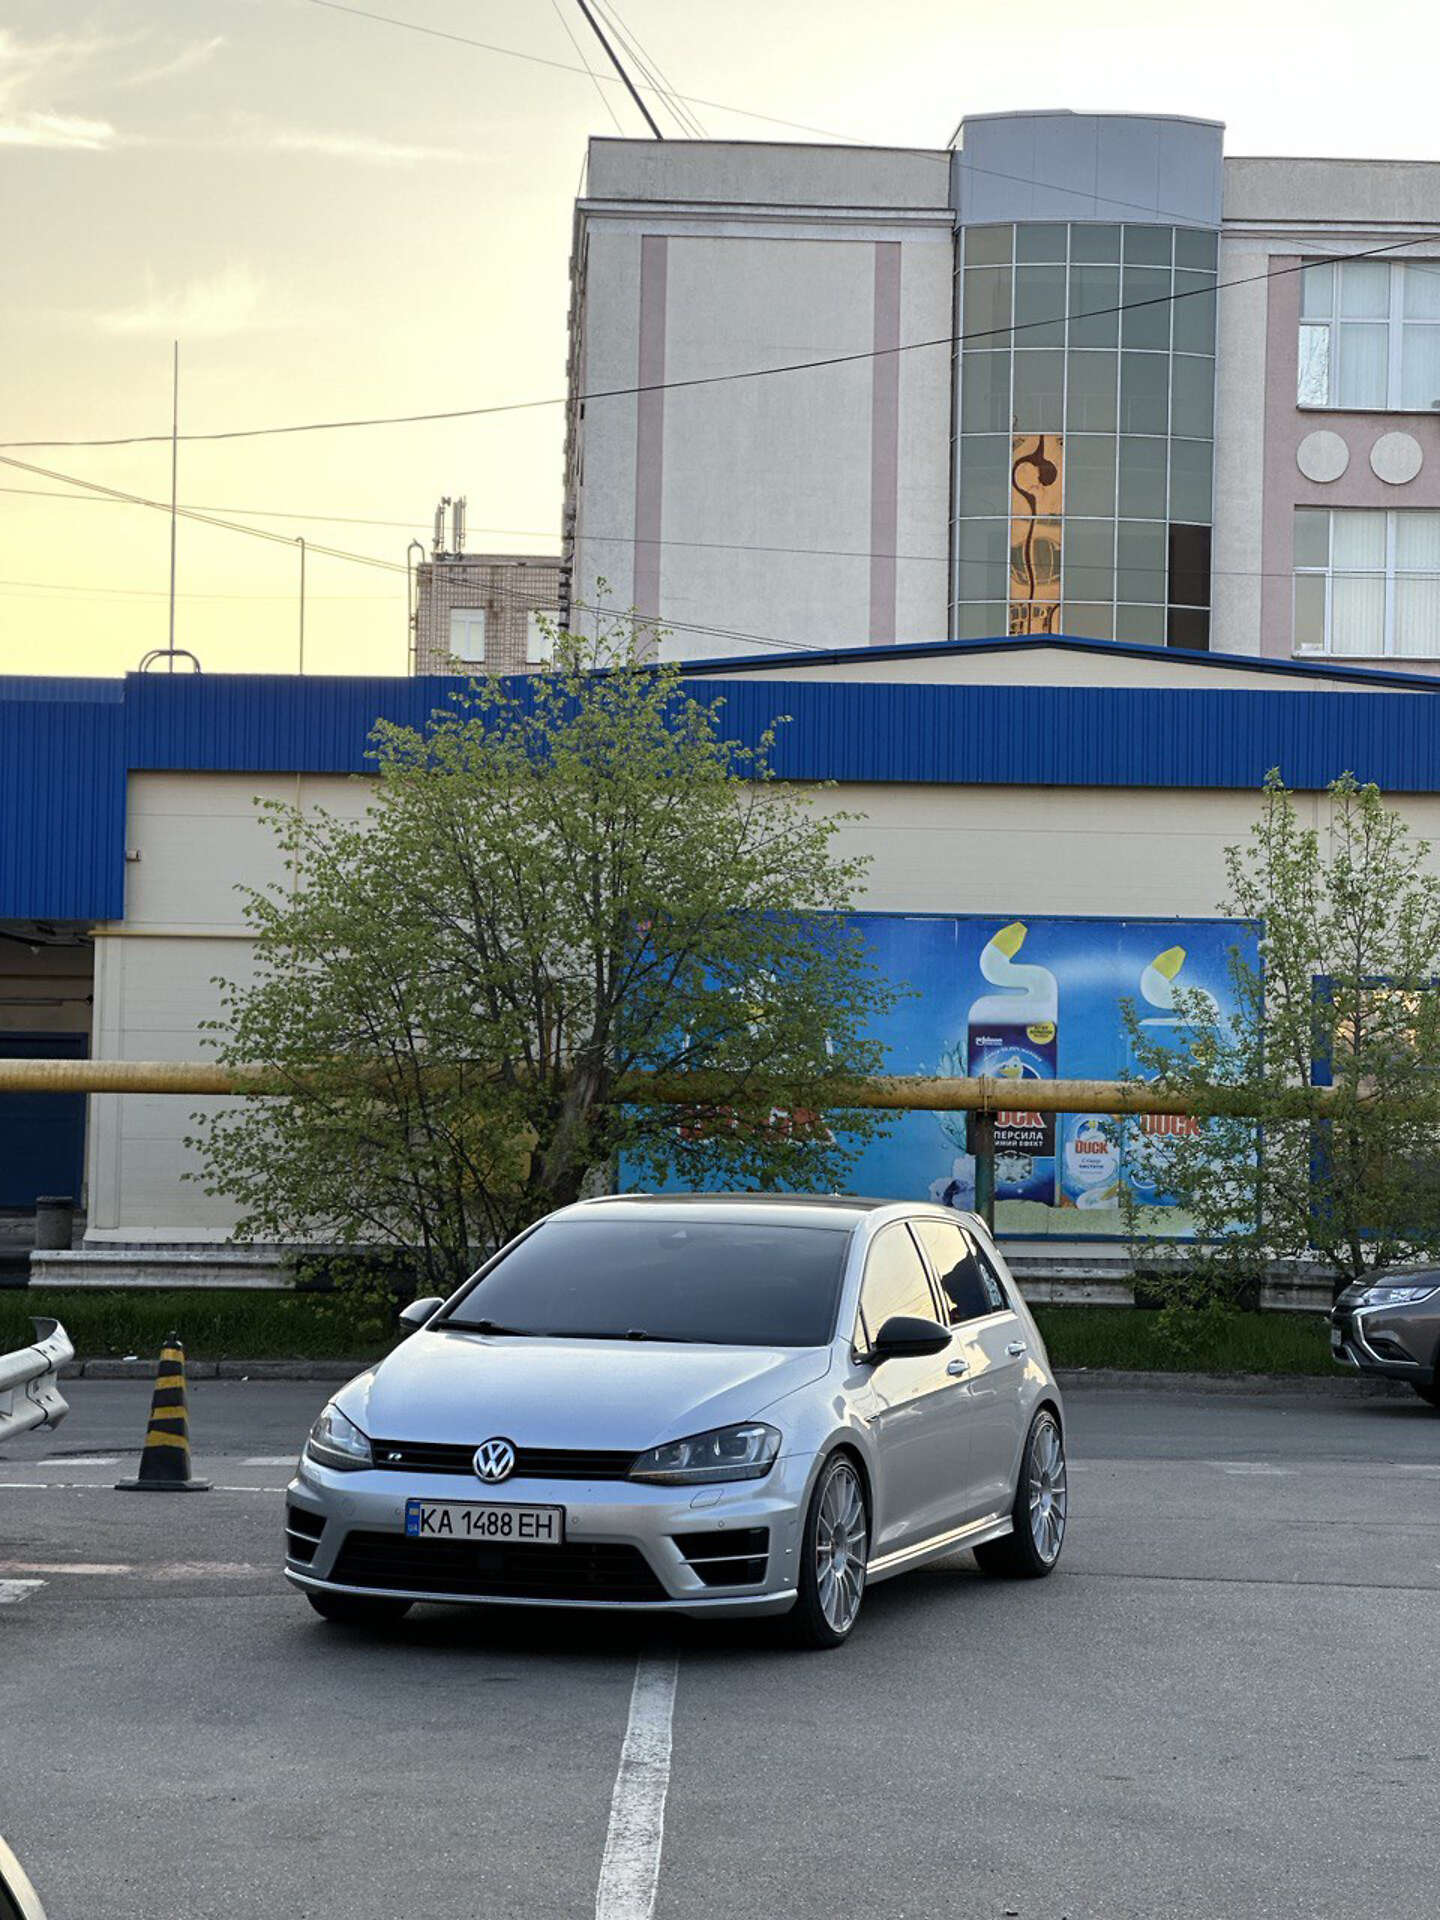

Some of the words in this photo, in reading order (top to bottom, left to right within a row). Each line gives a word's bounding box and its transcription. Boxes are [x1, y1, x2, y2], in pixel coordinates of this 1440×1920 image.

[994, 1111, 1046, 1127] UCK
[994, 1130, 1043, 1140] ПЕРСИЛА
[1075, 1140, 1108, 1153] DUCK
[420, 1508, 453, 1534] KA
[461, 1511, 512, 1536] 1488
[518, 1513, 552, 1538] EH
